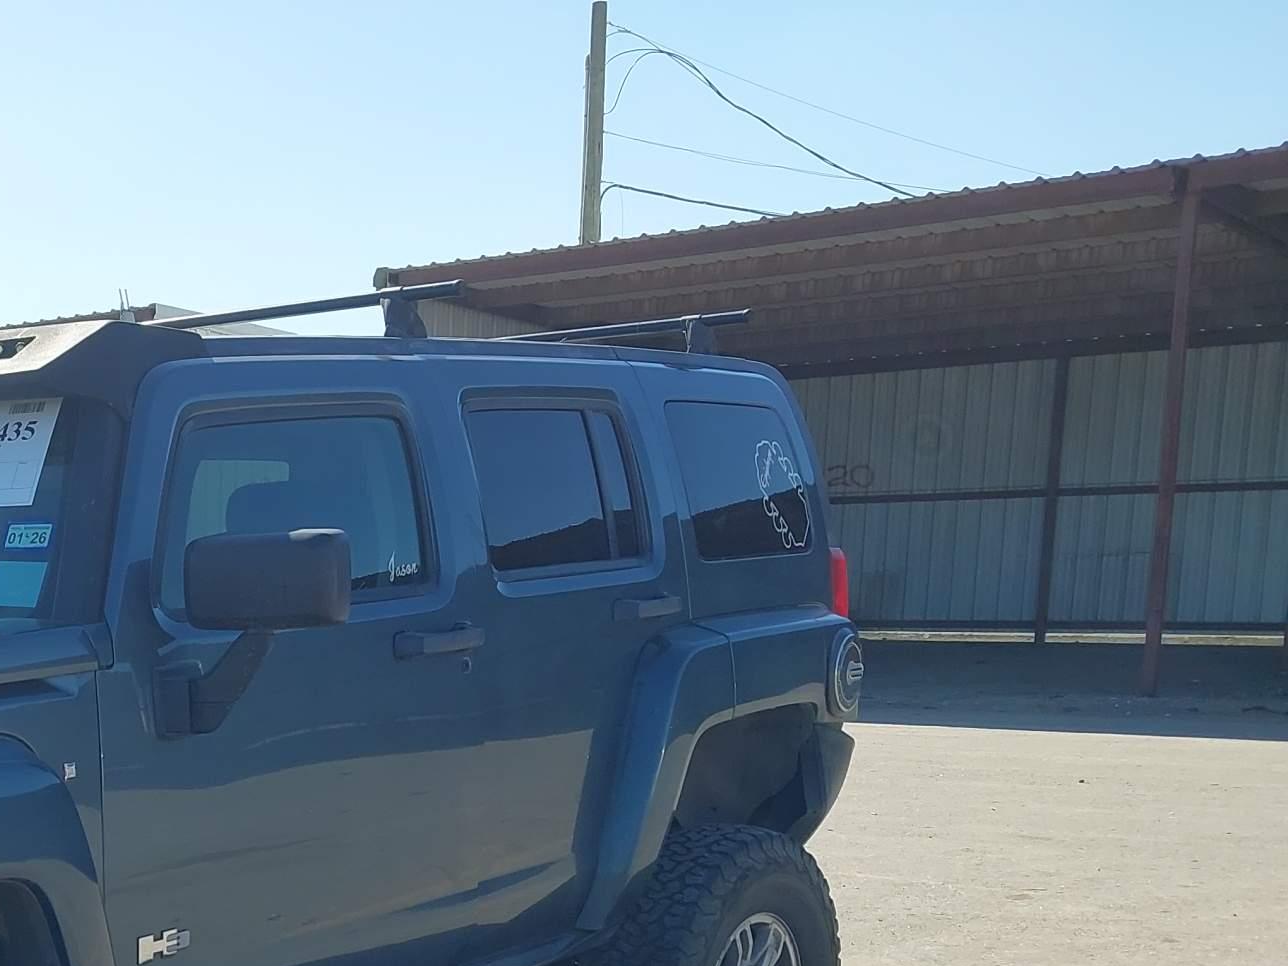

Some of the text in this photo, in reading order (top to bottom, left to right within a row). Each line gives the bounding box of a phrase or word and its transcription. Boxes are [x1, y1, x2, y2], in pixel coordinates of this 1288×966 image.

[826, 464, 875, 488] 20
[8, 531, 47, 544] 01 26
[388, 551, 418, 582] Jason
